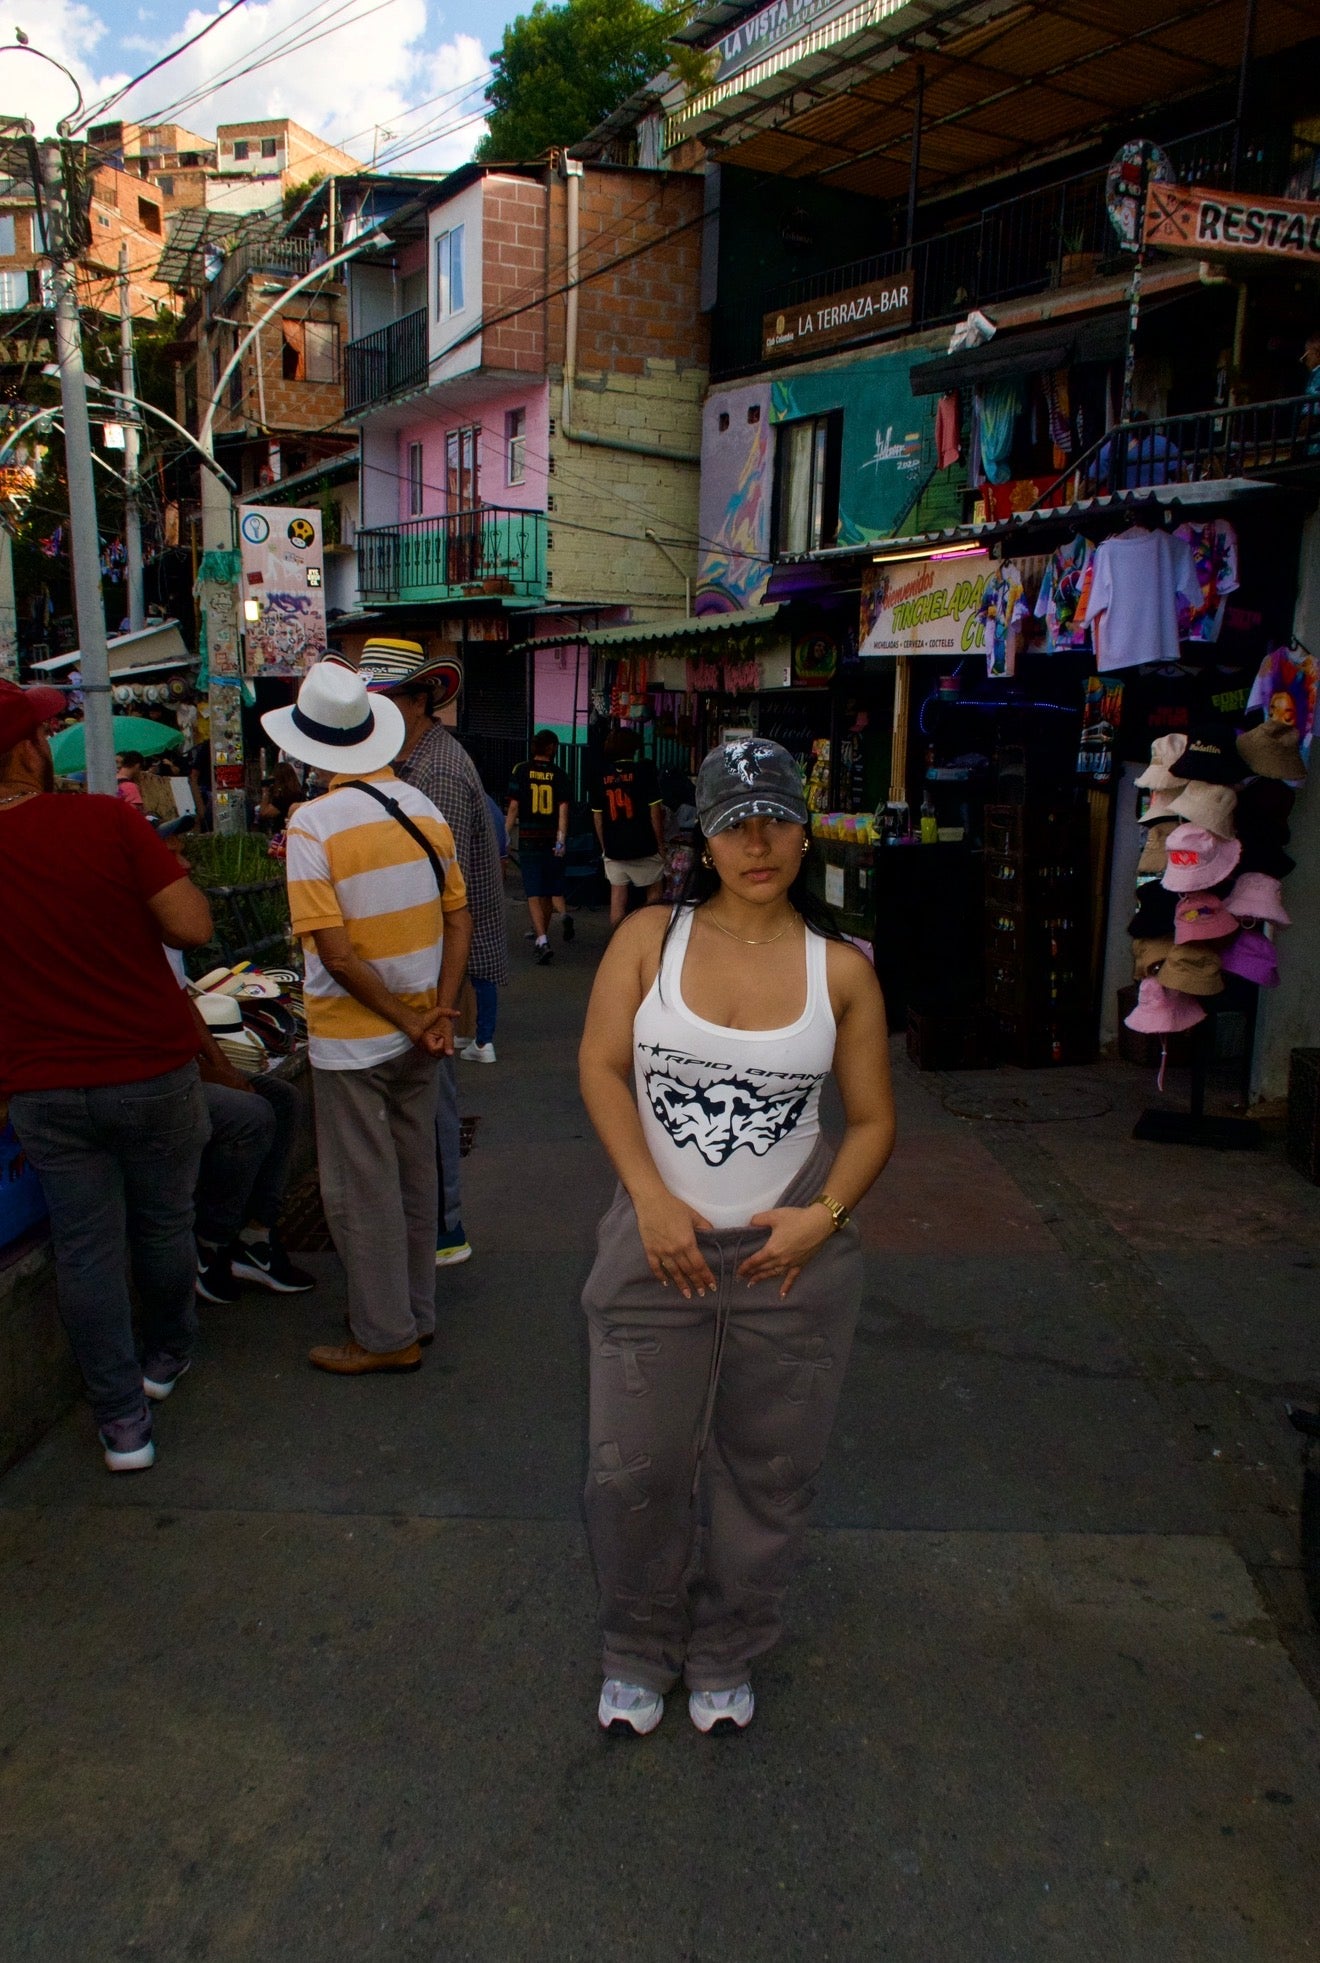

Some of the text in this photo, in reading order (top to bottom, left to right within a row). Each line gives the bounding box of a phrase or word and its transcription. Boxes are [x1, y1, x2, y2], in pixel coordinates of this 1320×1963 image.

[724, 29, 742, 60] LA
[745, 0, 788, 46] VISTA
[798, 285, 909, 336] LA TERRAZA-BAR
[903, 639, 924, 649] CERVEZA
[929, 638, 954, 648] COCTELES
[530, 783, 554, 816] 10
[604, 787, 637, 823] 14
